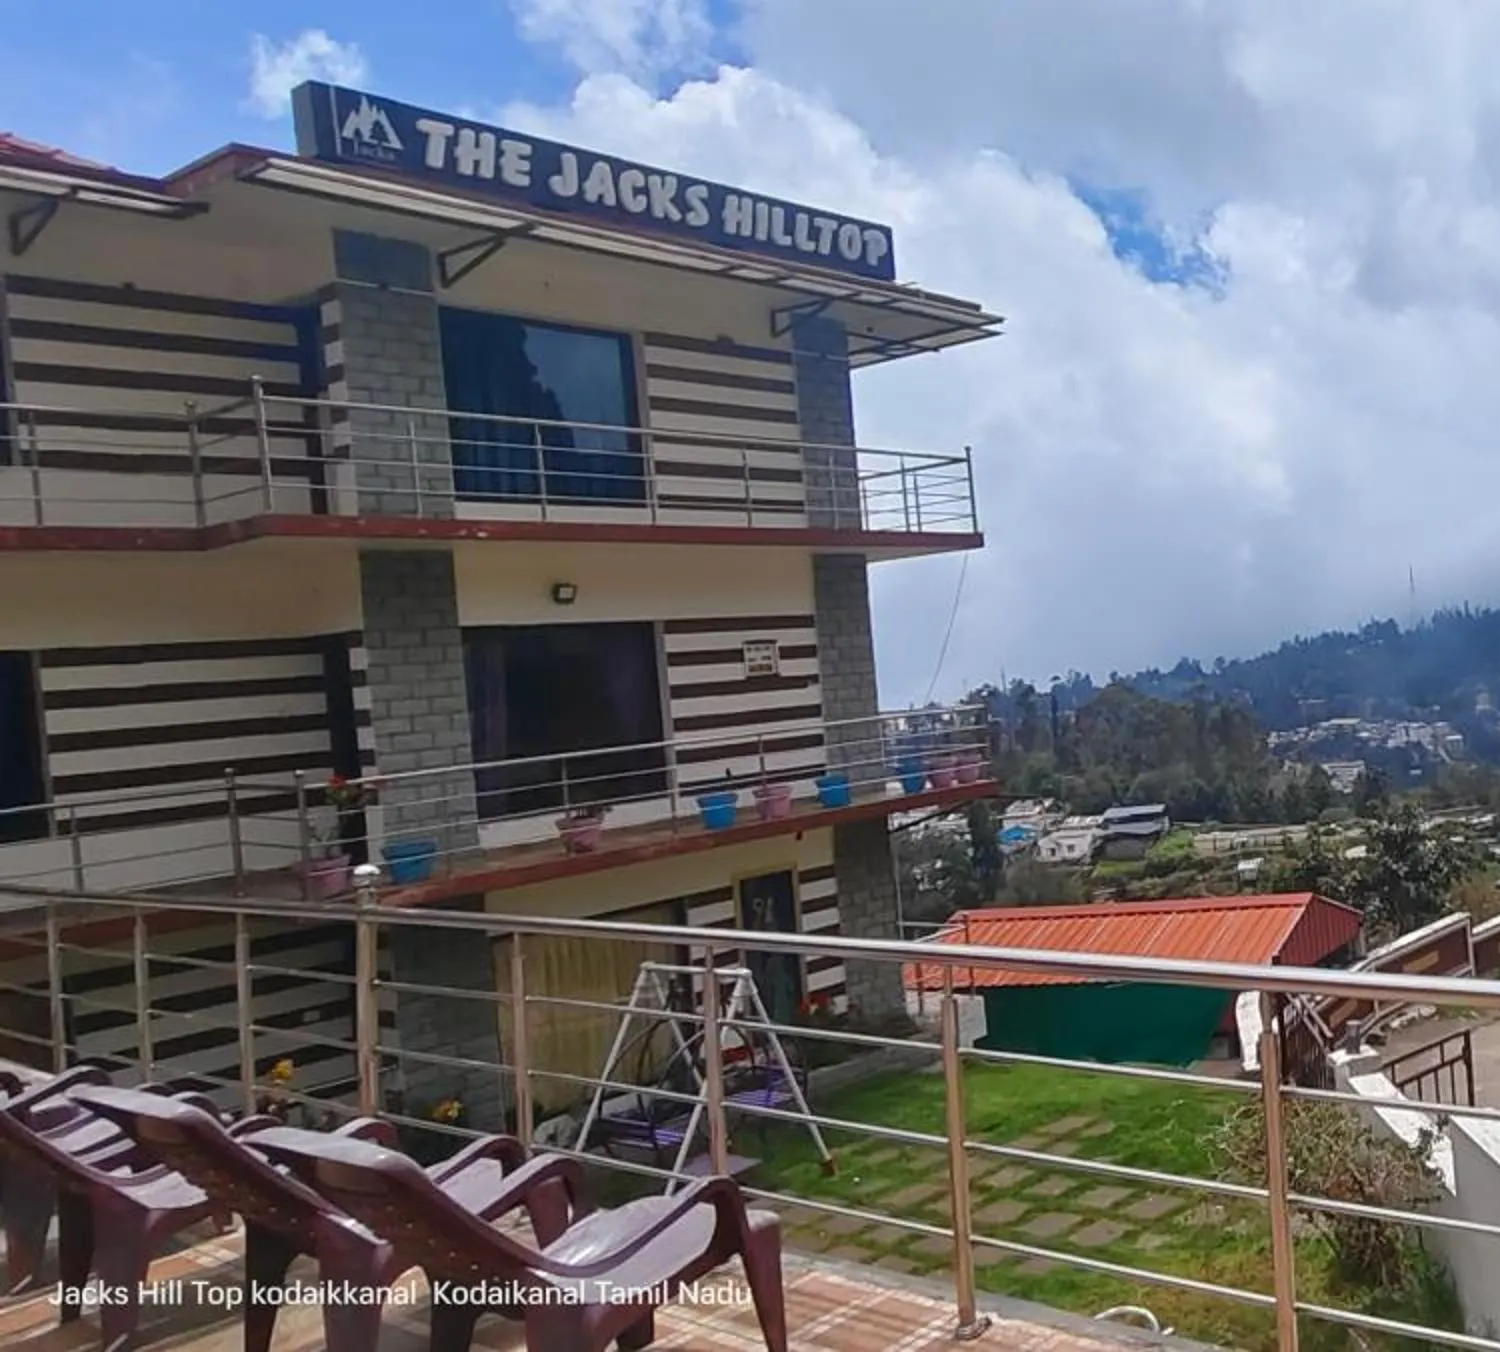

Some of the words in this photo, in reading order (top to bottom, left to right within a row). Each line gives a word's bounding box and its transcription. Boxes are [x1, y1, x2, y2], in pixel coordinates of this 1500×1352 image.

[416, 118, 532, 187] THE
[548, 152, 710, 227] JACKS
[722, 193, 888, 267] HILLTOP
